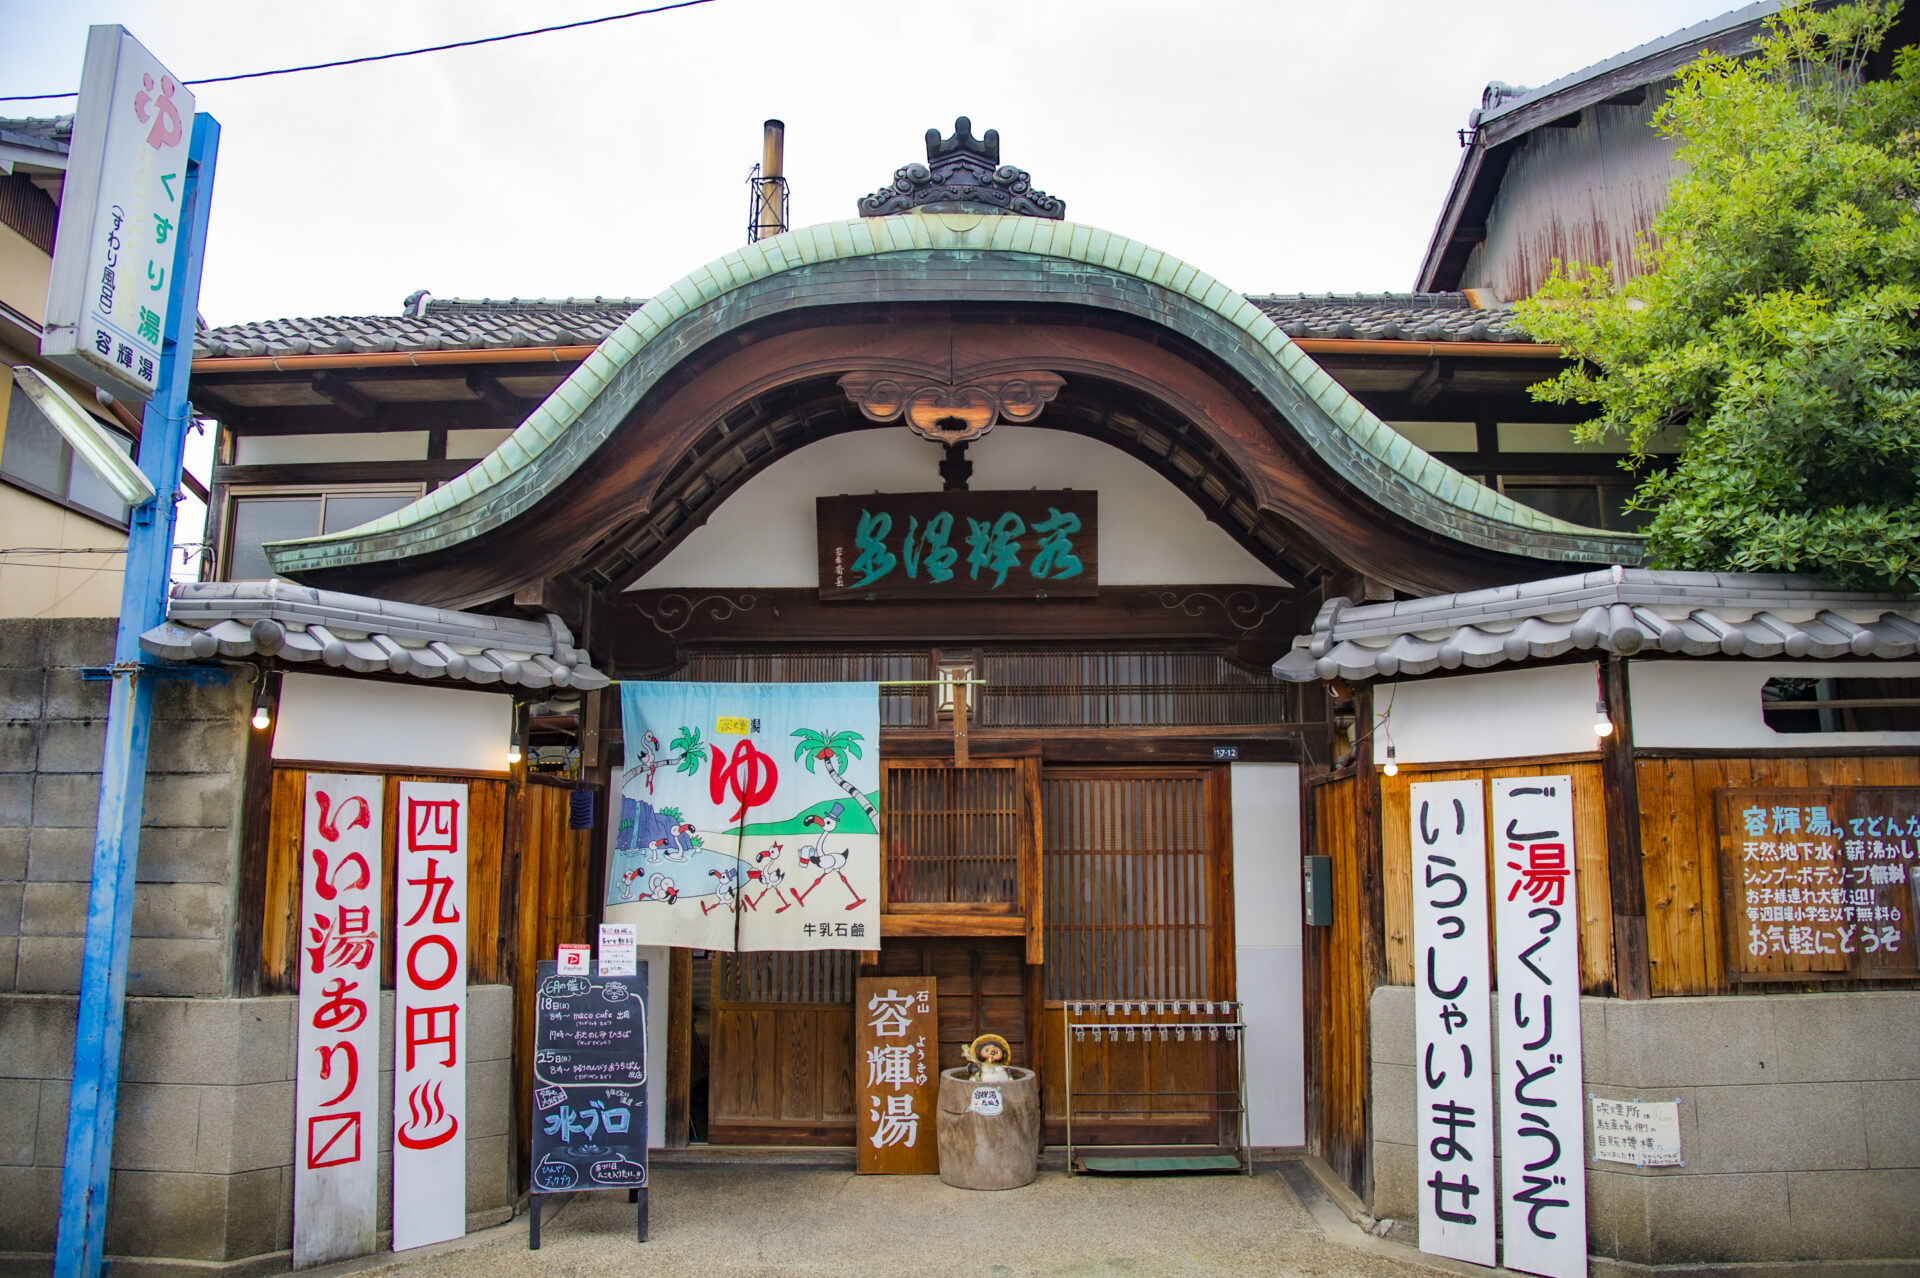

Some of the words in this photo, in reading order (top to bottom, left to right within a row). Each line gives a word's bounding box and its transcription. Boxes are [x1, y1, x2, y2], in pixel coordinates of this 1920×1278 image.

[134, 73, 182, 151] ゆ
[136, 173, 177, 347] くすり湯
[95, 328, 154, 383] 容輝湯
[709, 739, 779, 823] ゆ
[1746, 888, 1877, 906] お子様連れ大歓迎!
[1746, 906, 1891, 922] 毎週日曜小学生以下無料
[1748, 924, 1902, 957] お気軽にどうぞ
[595, 1009, 613, 1019] cafe
[916, 990, 930, 1014] 石山
[1420, 798, 1481, 1225] いらっしゃいませ
[1507, 786, 1571, 1240] ご湯っくりどうぞ
[866, 989, 920, 1149] 容輝湯
[1596, 1102, 1651, 1119] 喫煙所は
[1596, 1119, 1657, 1133] 駐車場側の
